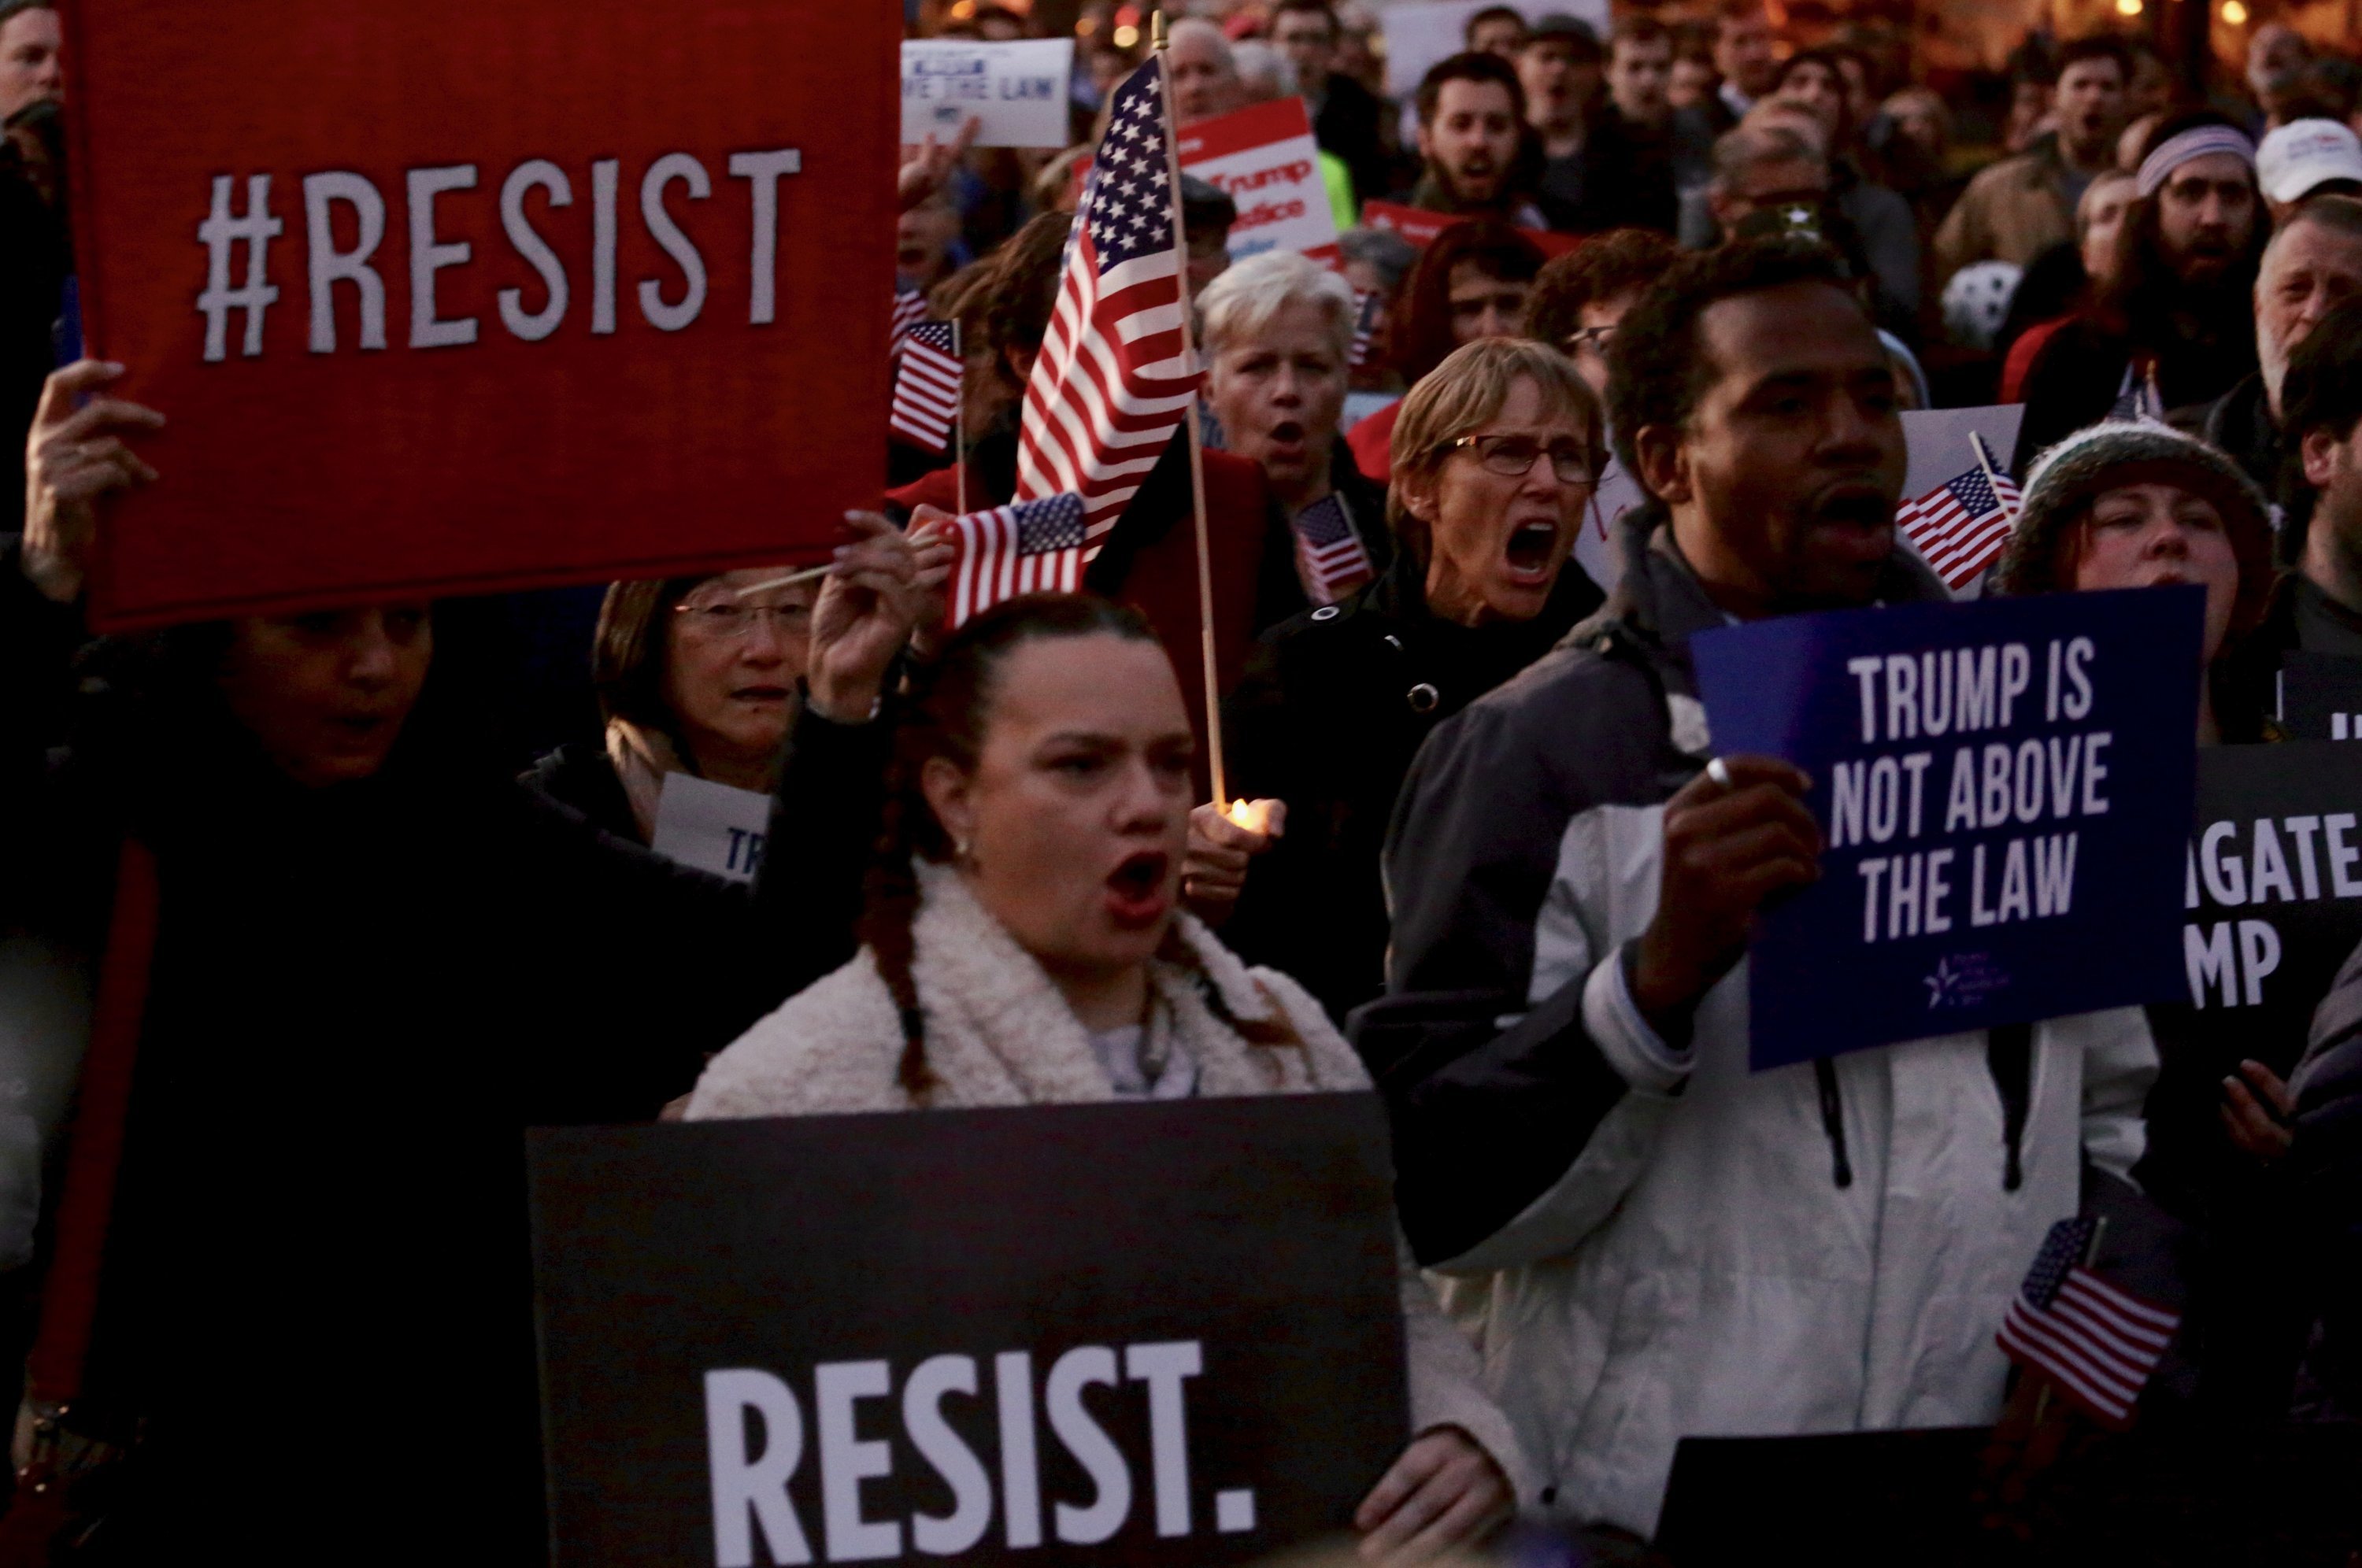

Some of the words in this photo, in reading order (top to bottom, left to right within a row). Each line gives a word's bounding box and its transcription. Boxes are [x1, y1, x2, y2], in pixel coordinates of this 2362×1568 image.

[196, 148, 802, 362] #RESIST
[1846, 642, 2031, 745] TRUMP
[2045, 634, 2096, 723] IS
[1829, 751, 1933, 849] NOT
[1943, 731, 2114, 833] ABOVE
[1857, 847, 1957, 945] THE
[1969, 830, 2079, 927] LAW
[2183, 919, 2282, 1010] MP
[703, 1339, 1257, 1568] RESIST.
